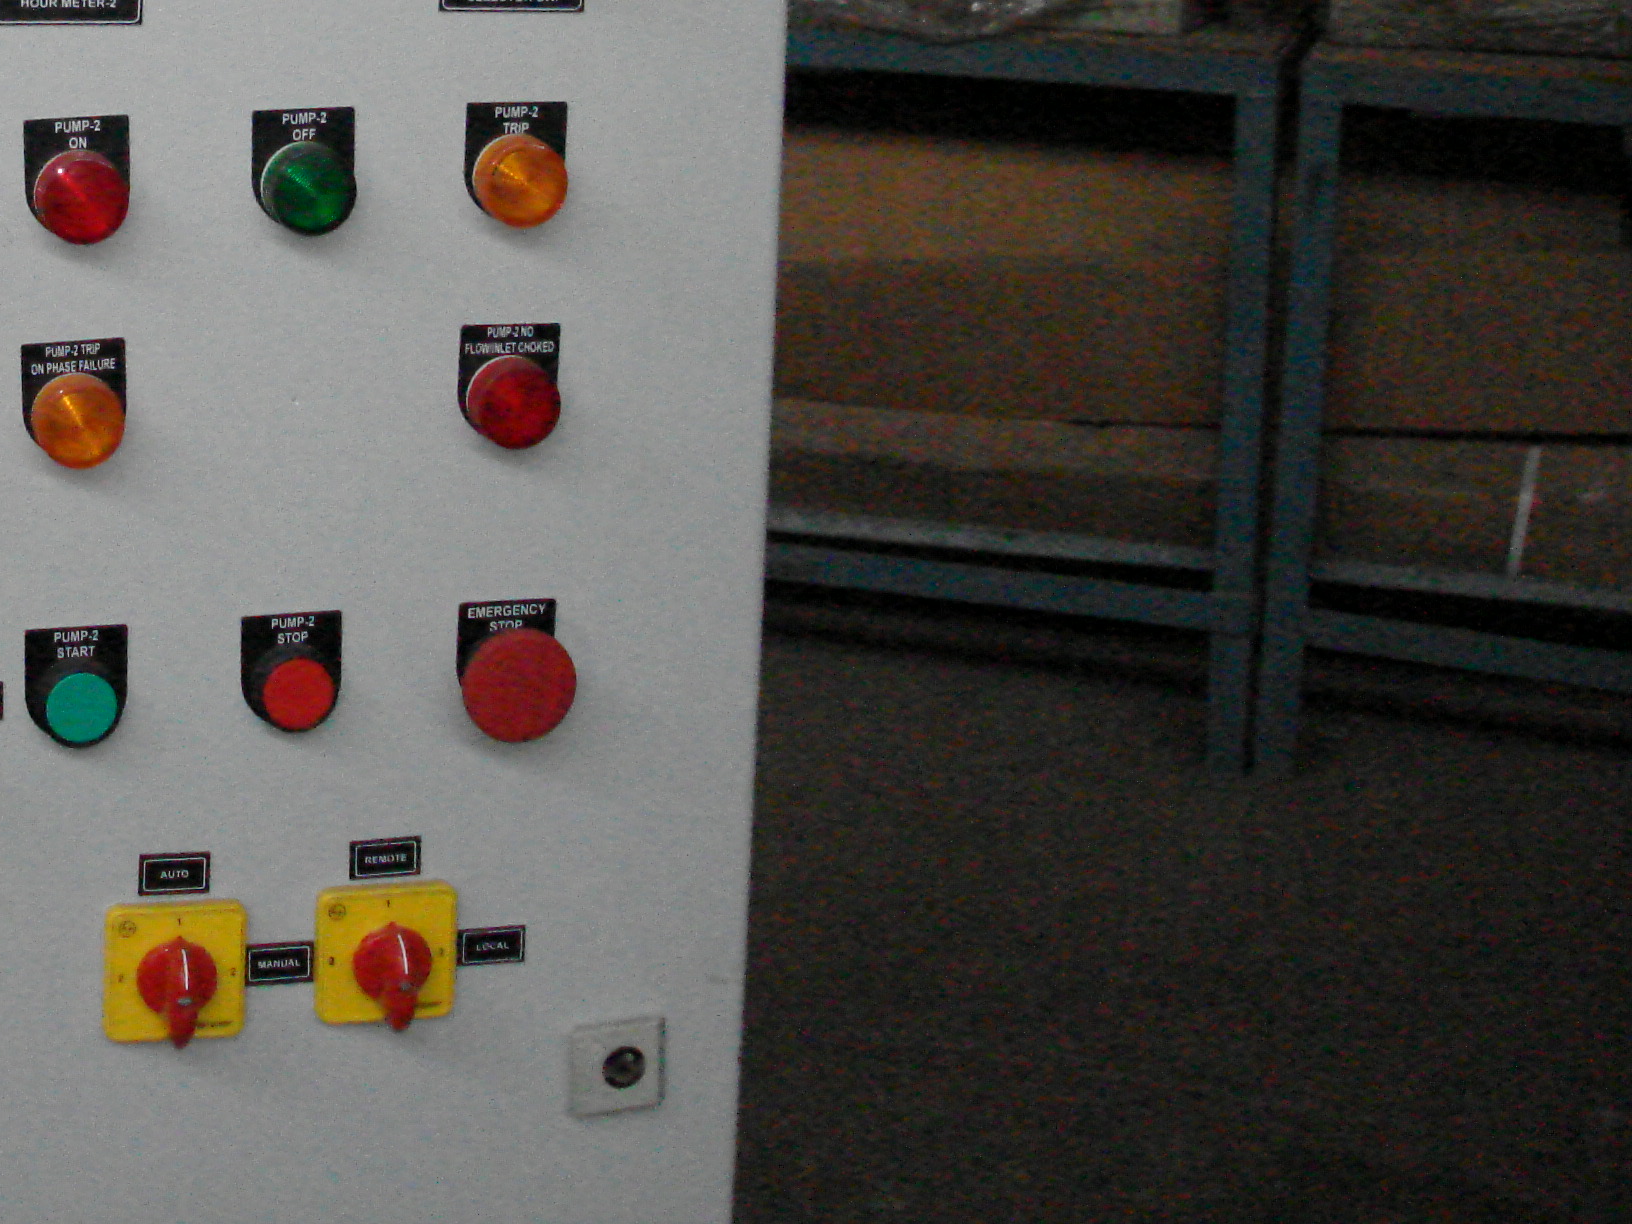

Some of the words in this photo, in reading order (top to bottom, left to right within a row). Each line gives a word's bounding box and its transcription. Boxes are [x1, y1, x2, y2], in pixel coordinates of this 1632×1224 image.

[494, 105, 539, 118] PUMP-2
[282, 112, 327, 125] PUMP-2
[54, 120, 101, 133] PUMP-2
[503, 122, 529, 134] TRIP
[292, 128, 316, 141] OFF
[69, 137, 88, 149] ON
[521, 326, 534, 337] NO
[45, 345, 78, 357] PUMP-2
[81, 343, 101, 354] TRIP
[518, 341, 555, 353] CHOKED
[31, 364, 44, 375] ON
[47, 361, 77, 373] PHASE
[79, 358, 115, 371] FAILURE
[468, 603, 546, 619] EMERGENCY
[271, 616, 315, 629] PUMP-2
[489, 620, 523, 631] STOP
[54, 630, 99, 643] PUMP-2
[277, 631, 309, 644] STOP
[57, 646, 95, 659] START
[365, 853, 407, 864] REMOTE
[160, 870, 189, 879] AUTO
[476, 941, 509, 951] LOCAL
[257, 959, 300, 969] MANUAL
